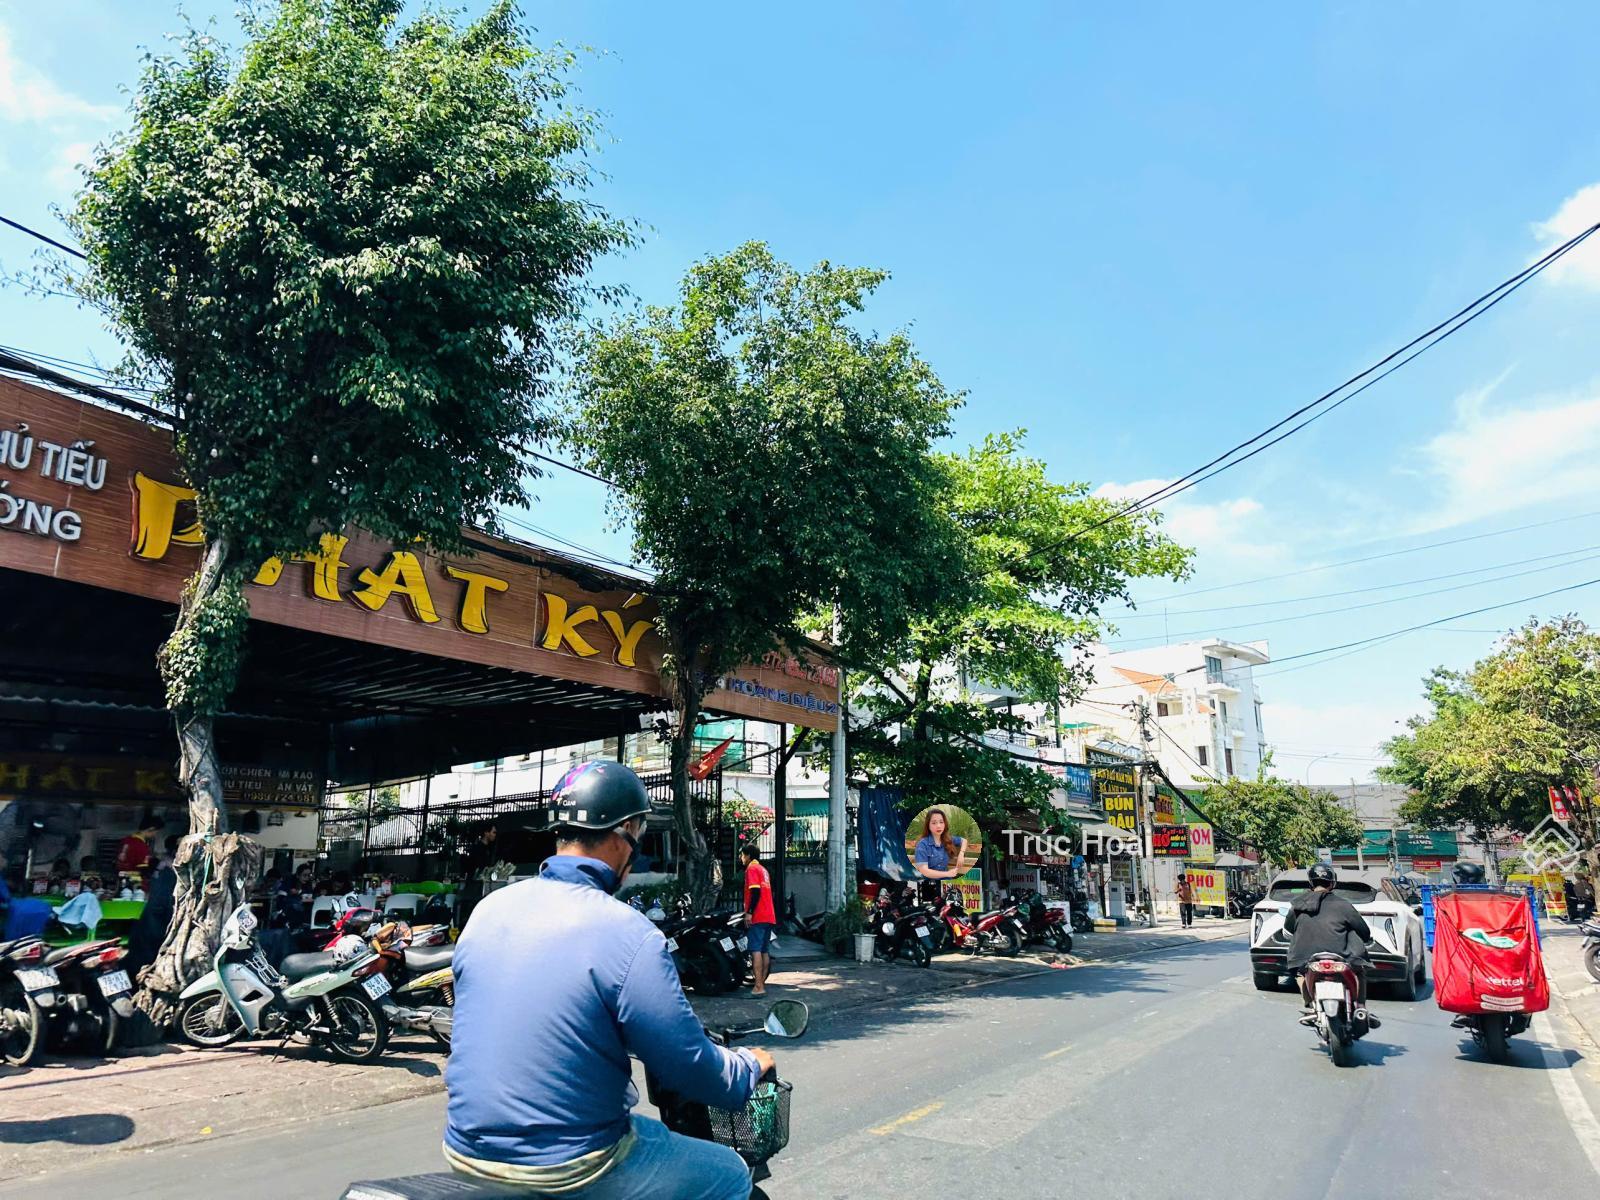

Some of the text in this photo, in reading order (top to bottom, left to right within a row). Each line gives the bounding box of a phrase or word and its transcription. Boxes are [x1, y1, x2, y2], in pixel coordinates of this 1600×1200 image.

[38, 440, 107, 490] TIẾU
[539, 591, 655, 668] KÝ
[1105, 795, 1134, 811] BÚN
